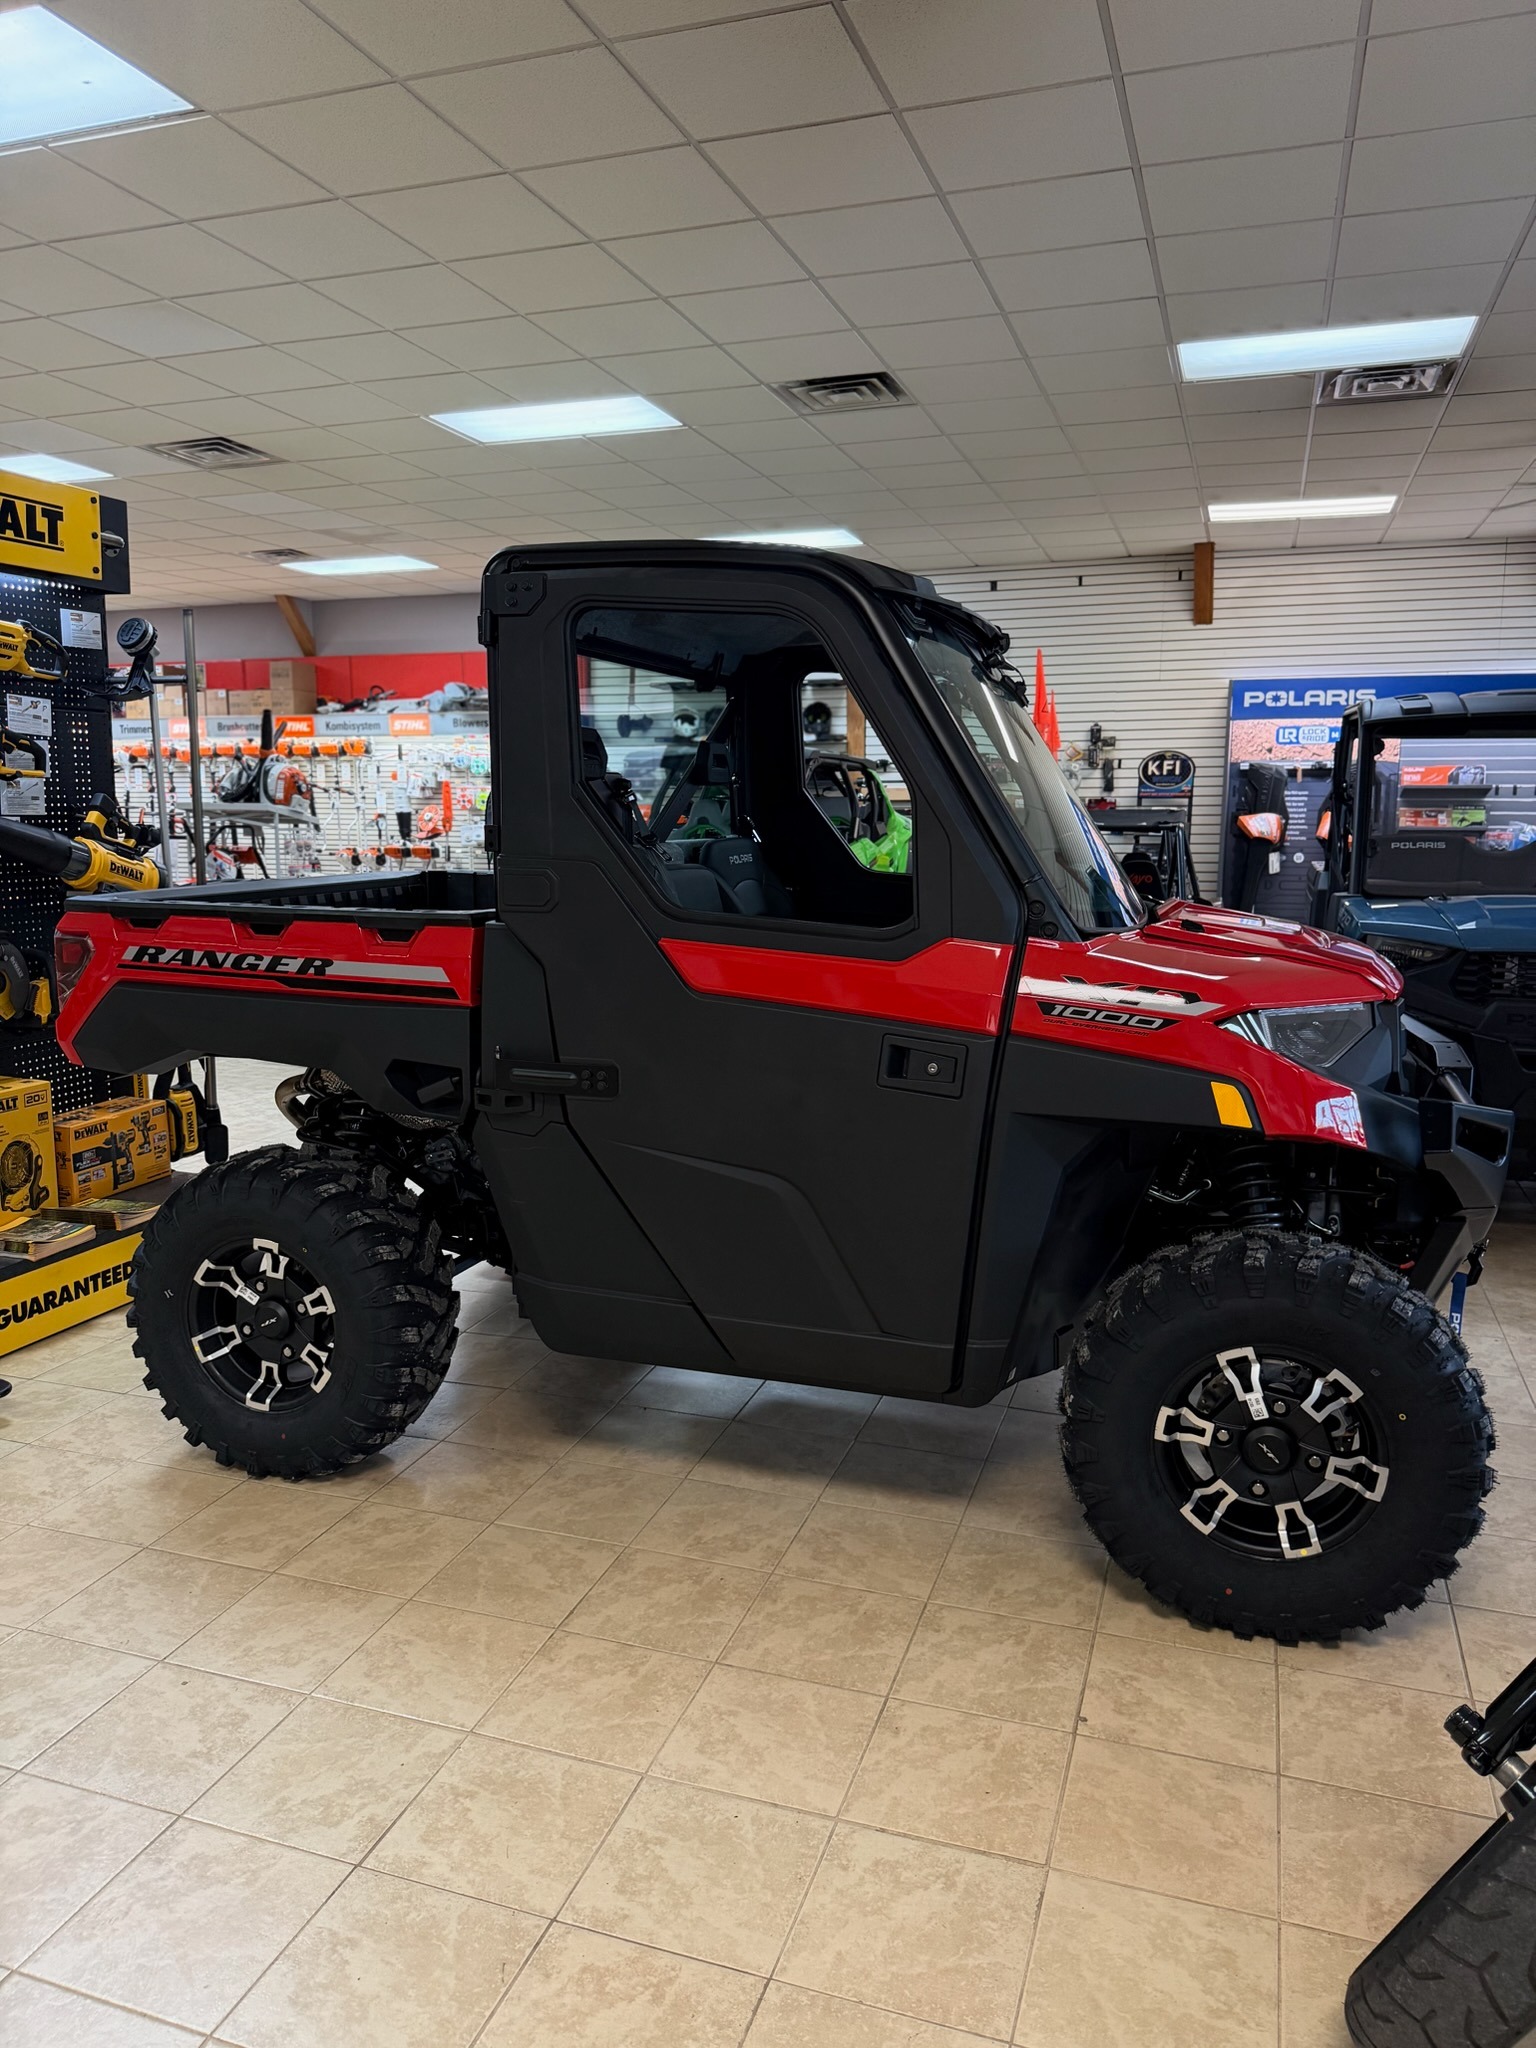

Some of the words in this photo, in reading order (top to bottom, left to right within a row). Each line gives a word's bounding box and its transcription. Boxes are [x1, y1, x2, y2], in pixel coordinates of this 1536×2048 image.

[1243, 689, 1376, 708] POLARIS
[325, 720, 381, 734] Kombisystem
[393, 720, 427, 731] STIHL
[452, 717, 489, 728] Blowers
[1147, 759, 1181, 776] KFI
[1391, 841, 1446, 849] POLARIS
[729, 853, 753, 865] POLARIS
[110, 860, 145, 883] DEWALT
[130, 945, 335, 977] RANGER
[1050, 1004, 1164, 1029] 1000
[1043, 1018, 1070, 1027] DUAL
[1071, 1021, 1126, 1034] OVERHEAD
[1126, 1028, 1151, 1038] CAM
[74, 1121, 109, 1141] DEWALT
